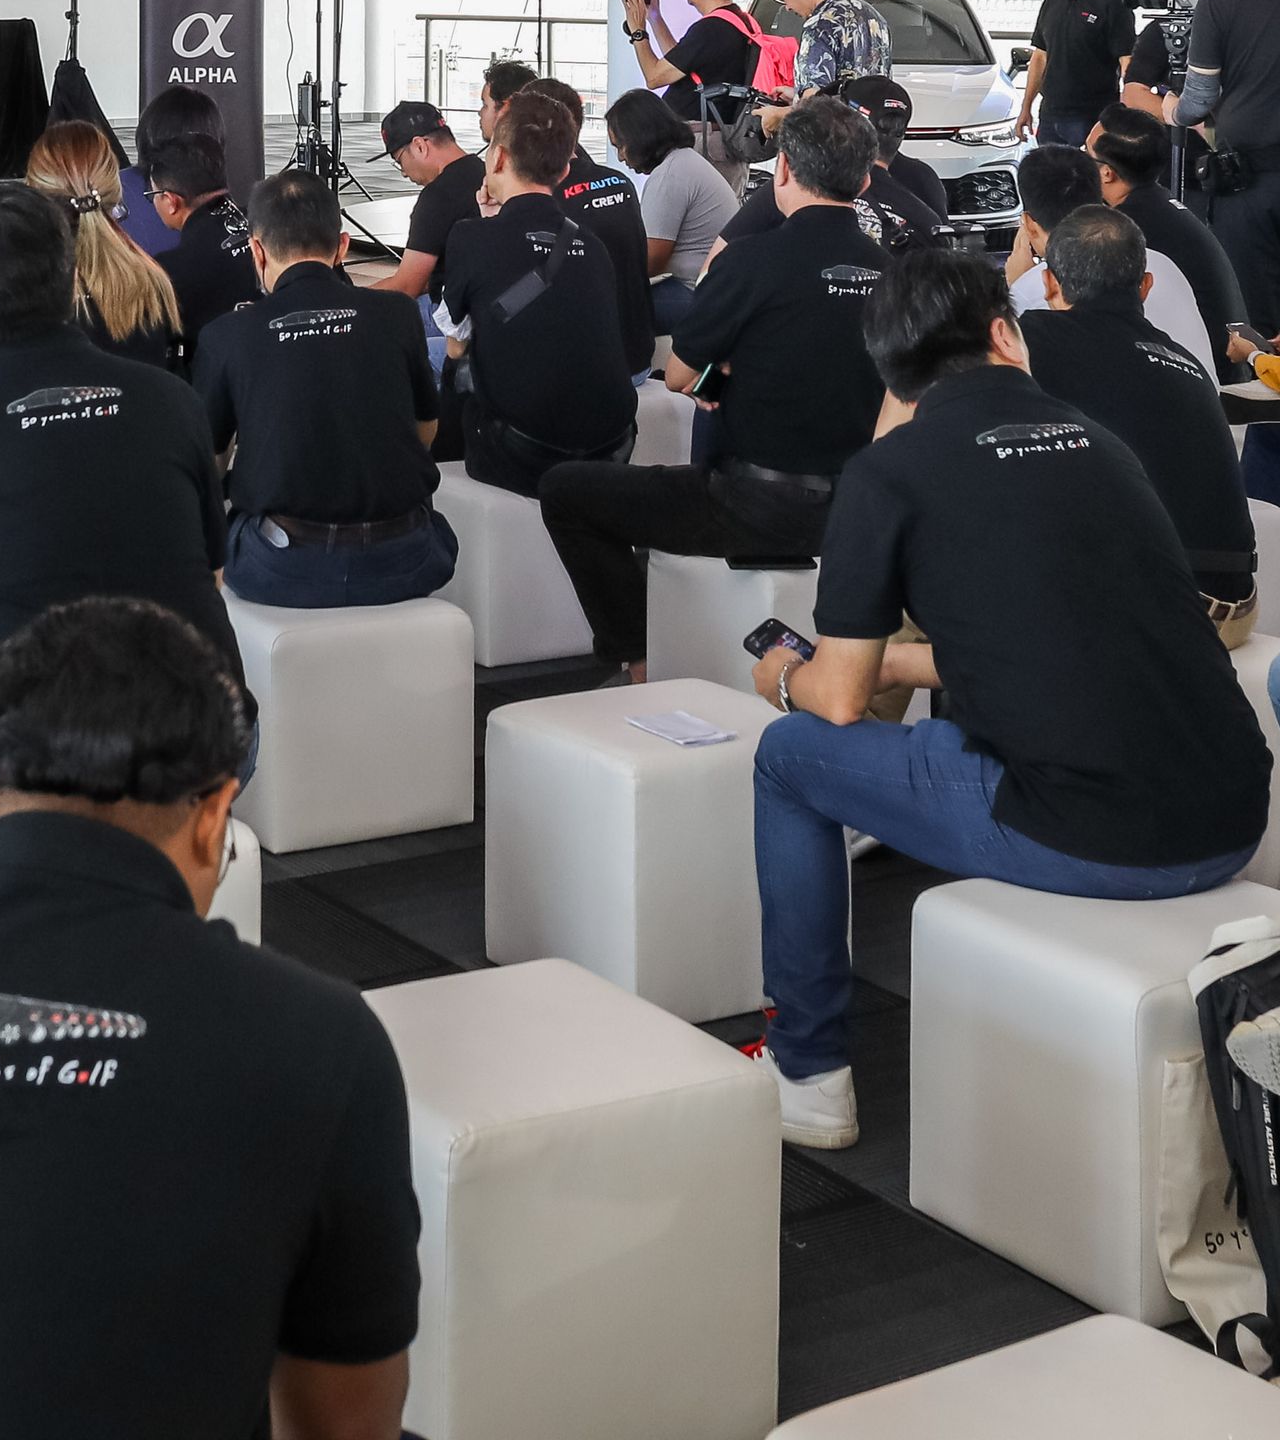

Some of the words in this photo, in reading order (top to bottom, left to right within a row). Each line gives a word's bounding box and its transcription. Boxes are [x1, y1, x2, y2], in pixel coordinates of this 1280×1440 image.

[168, 67, 237, 83] ALPHA
[592, 193, 624, 208] CREW
[279, 332, 291, 342] 50
[21, 416, 37, 430] 50
[996, 447, 1013, 459] 50
[25, 1055, 54, 1086] of
[1205, 1232, 1225, 1254] 50
